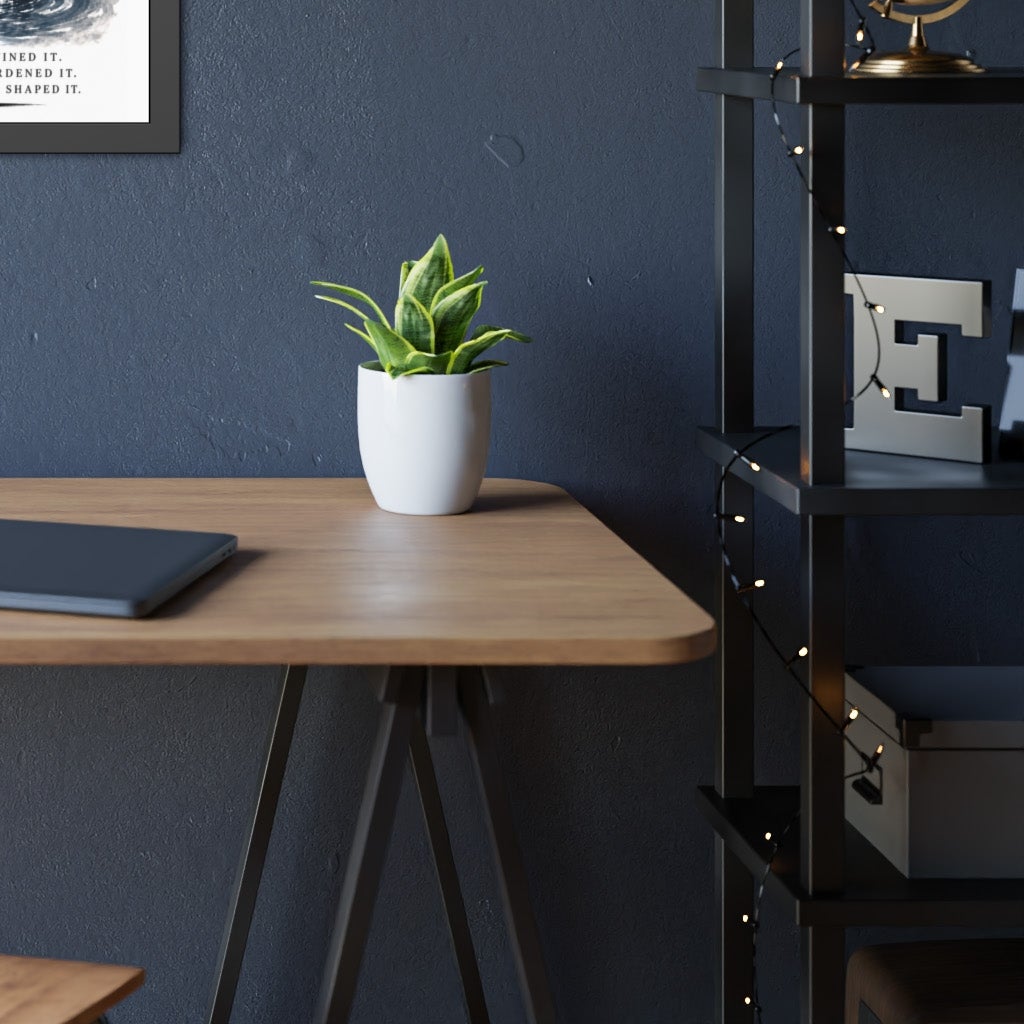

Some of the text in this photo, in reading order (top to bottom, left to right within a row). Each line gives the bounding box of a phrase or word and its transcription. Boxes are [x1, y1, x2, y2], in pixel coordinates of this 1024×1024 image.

[44, 52, 63, 62] IT.
[59, 68, 77, 78] IT.
[5, 84, 60, 94] SHAPED
[65, 84, 81, 94] IT.
